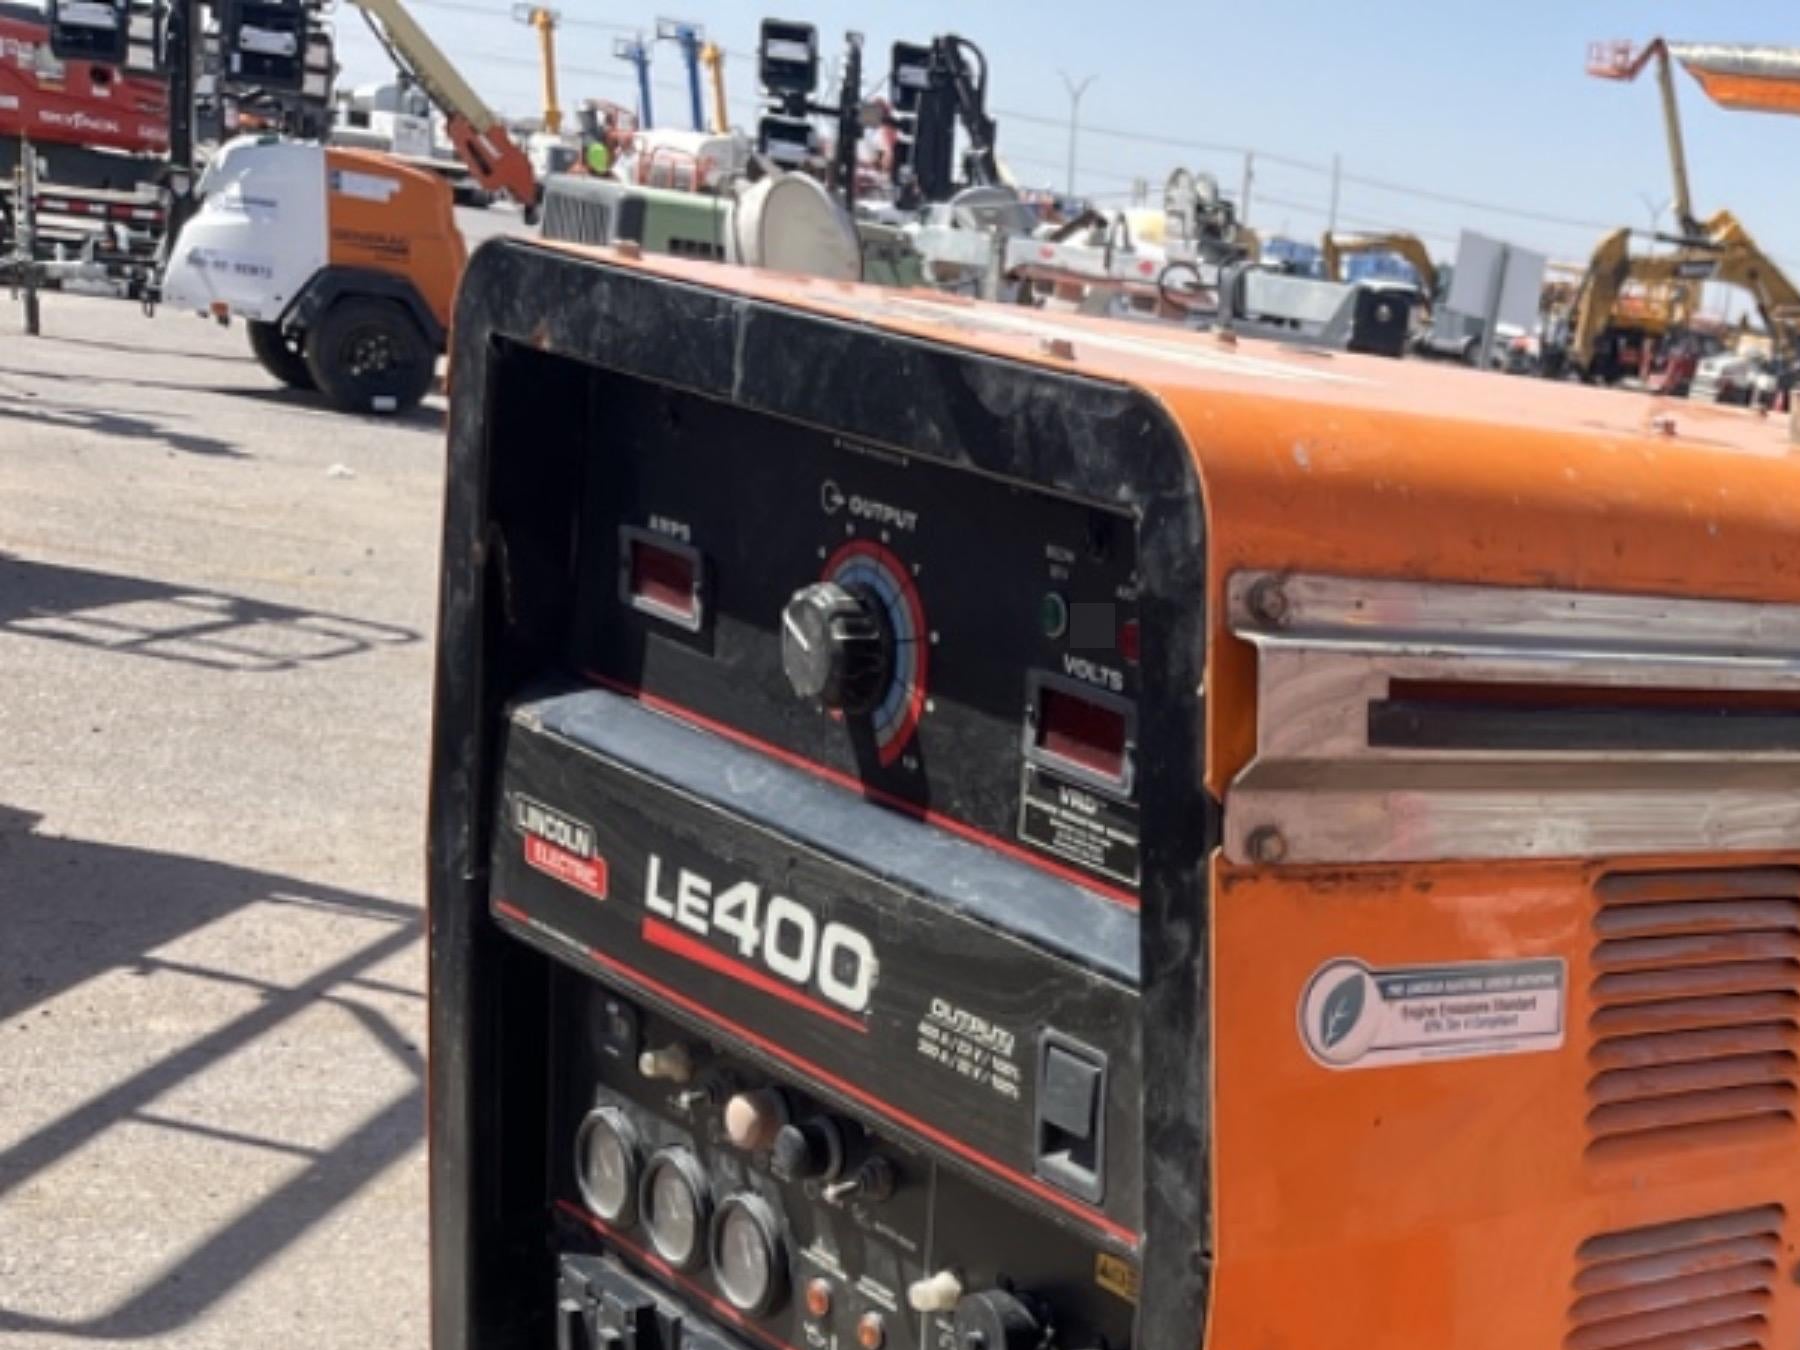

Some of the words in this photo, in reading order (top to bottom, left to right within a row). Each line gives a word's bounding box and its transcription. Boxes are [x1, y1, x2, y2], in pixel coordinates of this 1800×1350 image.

[848, 494, 919, 532] OUTPUT
[1062, 652, 1124, 692] VOLTS
[514, 798, 592, 859] LINCOLN
[644, 852, 876, 1013] LE400
